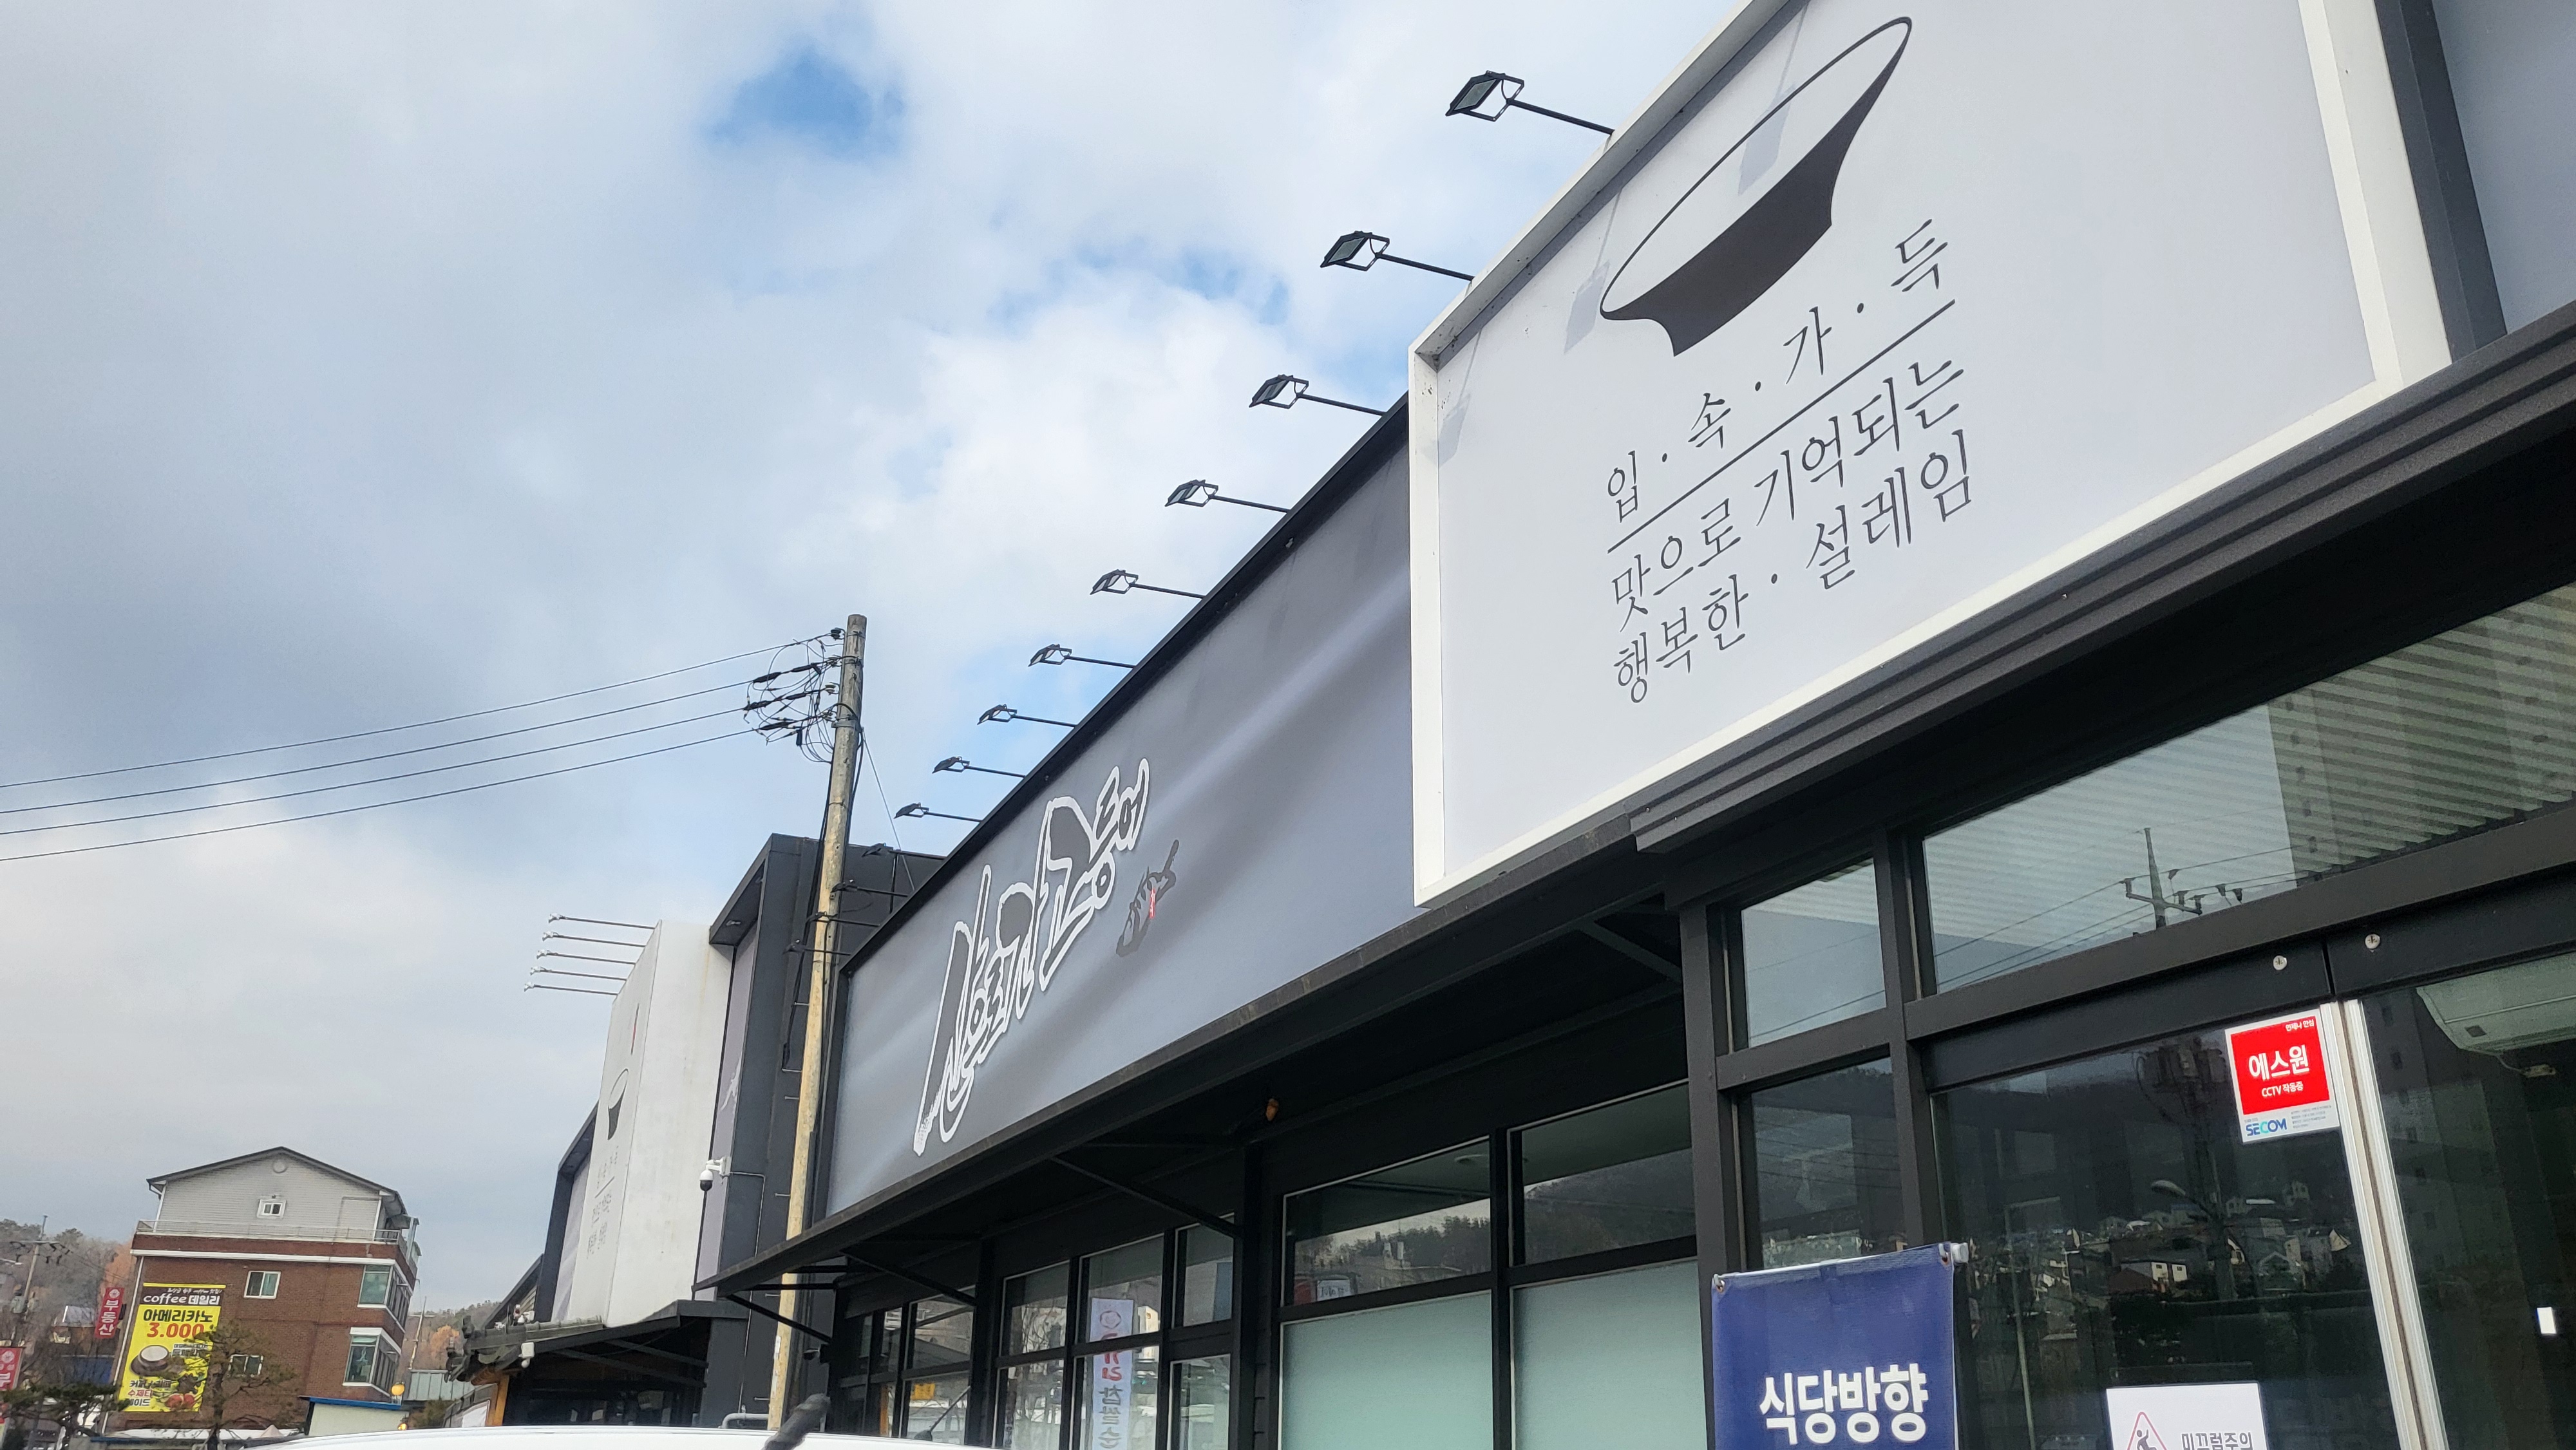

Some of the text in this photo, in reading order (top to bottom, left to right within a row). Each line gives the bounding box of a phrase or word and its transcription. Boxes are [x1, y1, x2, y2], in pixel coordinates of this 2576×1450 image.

[1611, 359, 1964, 634] 맛으로 기억되는
[1613, 429, 1972, 703] 행복한 설레임
[2286, 1018, 2315, 1031] 언제나 안심
[2248, 1044, 2311, 1081] 에스원
[2261, 1081, 2304, 1098] CCTV 작동중
[2245, 1118, 2287, 1137] SECOM
[143, 1294, 221, 1305] coffee 데일리
[99, 1299, 120, 1335] 부동산
[143, 1308, 213, 1323] 아메리카노
[1759, 1362, 1929, 1445] 식당방향
